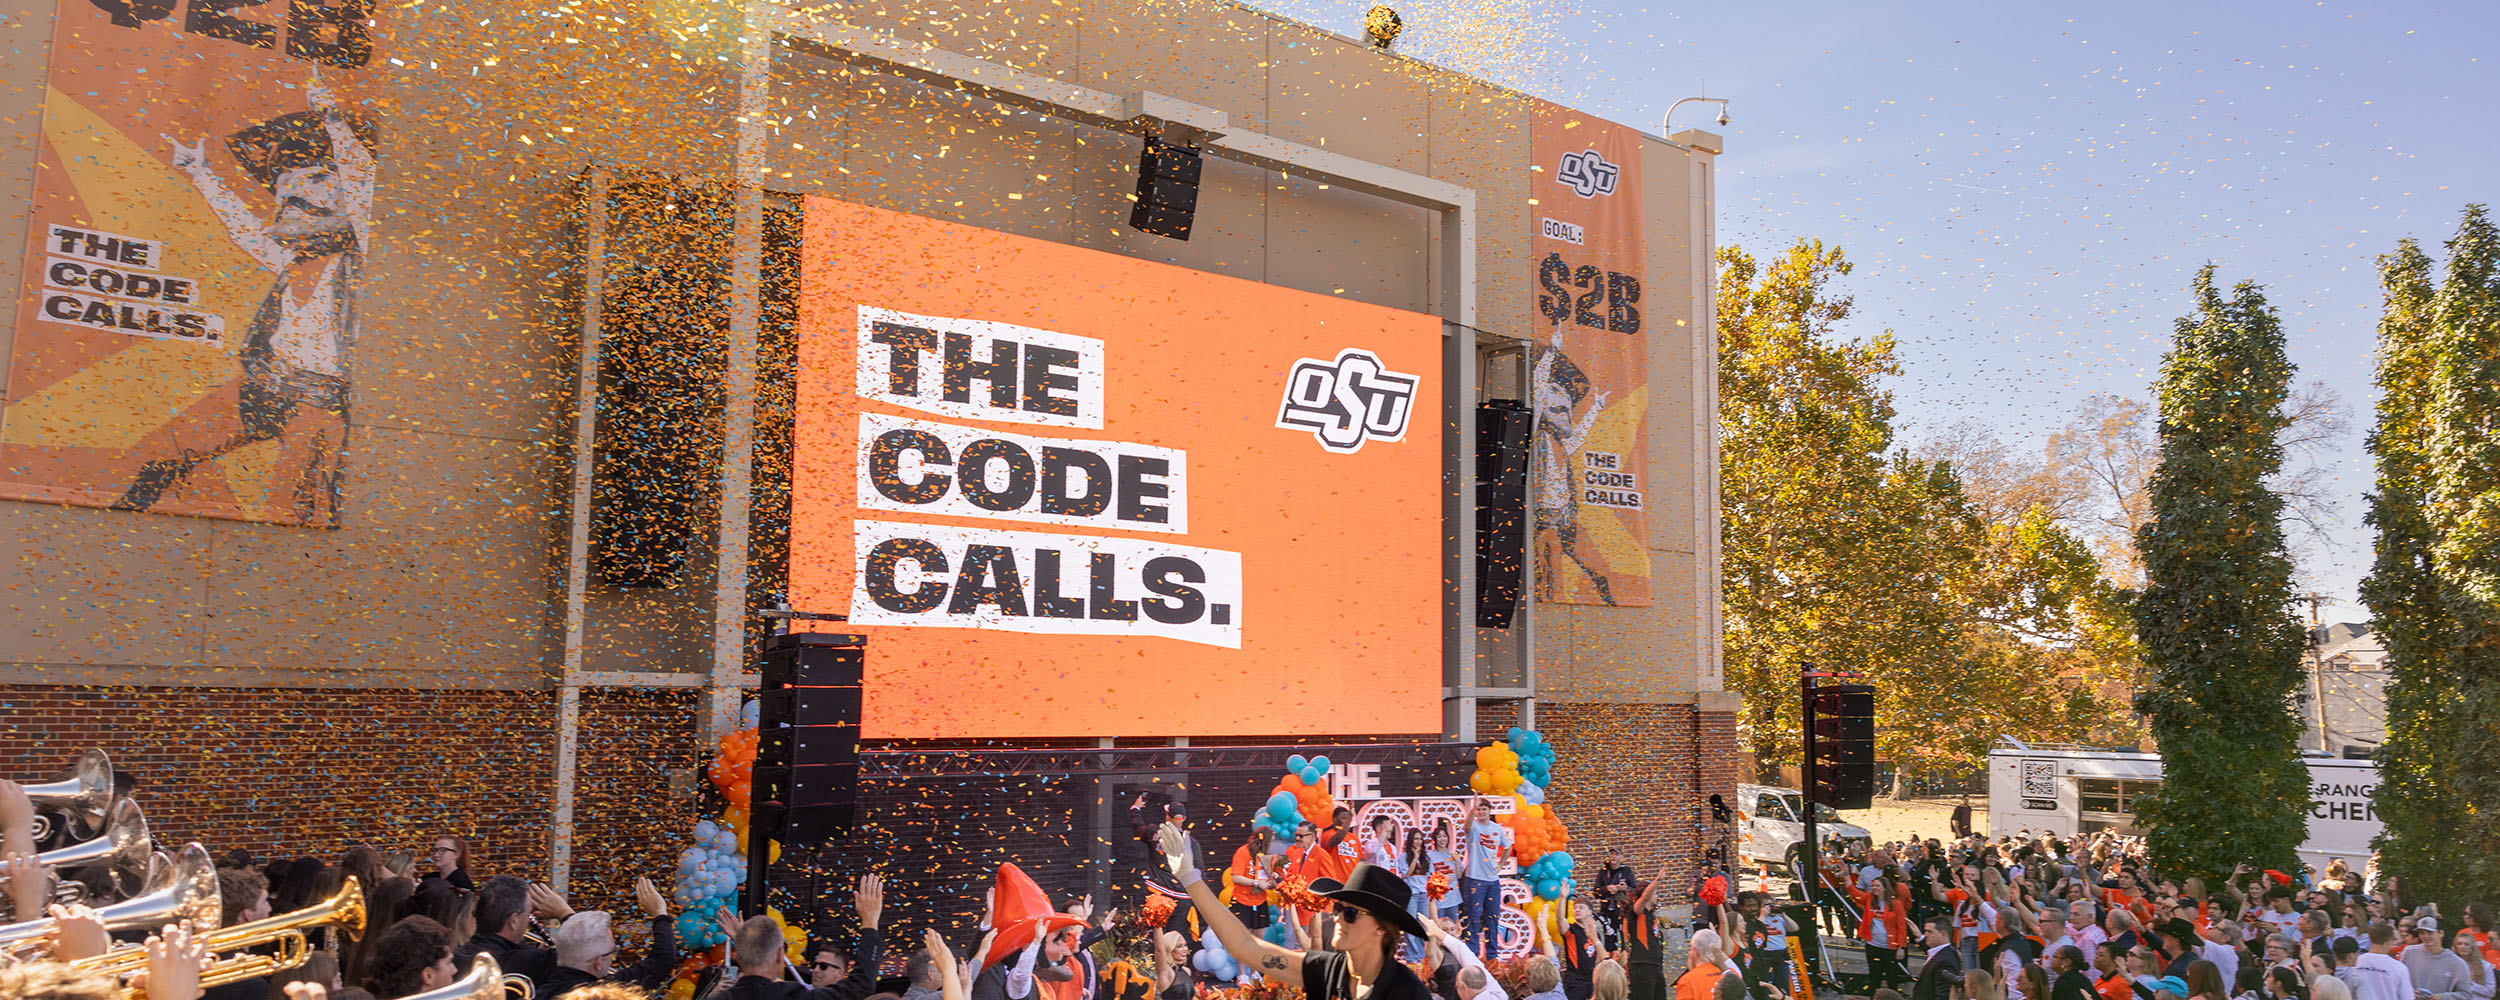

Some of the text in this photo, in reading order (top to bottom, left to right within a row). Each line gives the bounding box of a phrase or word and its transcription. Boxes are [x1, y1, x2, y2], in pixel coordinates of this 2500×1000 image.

[1556, 150, 1620, 199] OSU
[55, 229, 149, 266] THE
[1543, 221, 1583, 243] GOAL:
[49, 262, 190, 304] CODE
[1539, 253, 1641, 335] $2B
[45, 296, 218, 340] CALLS.
[872, 321, 1079, 417] THE
[1276, 348, 1419, 453] OSU
[869, 429, 1170, 523] CODE
[1585, 452, 1616, 468] THE
[1585, 471, 1633, 488] CODE
[1585, 490, 1641, 507] CALLS.
[865, 537, 1231, 625] CALLS.
